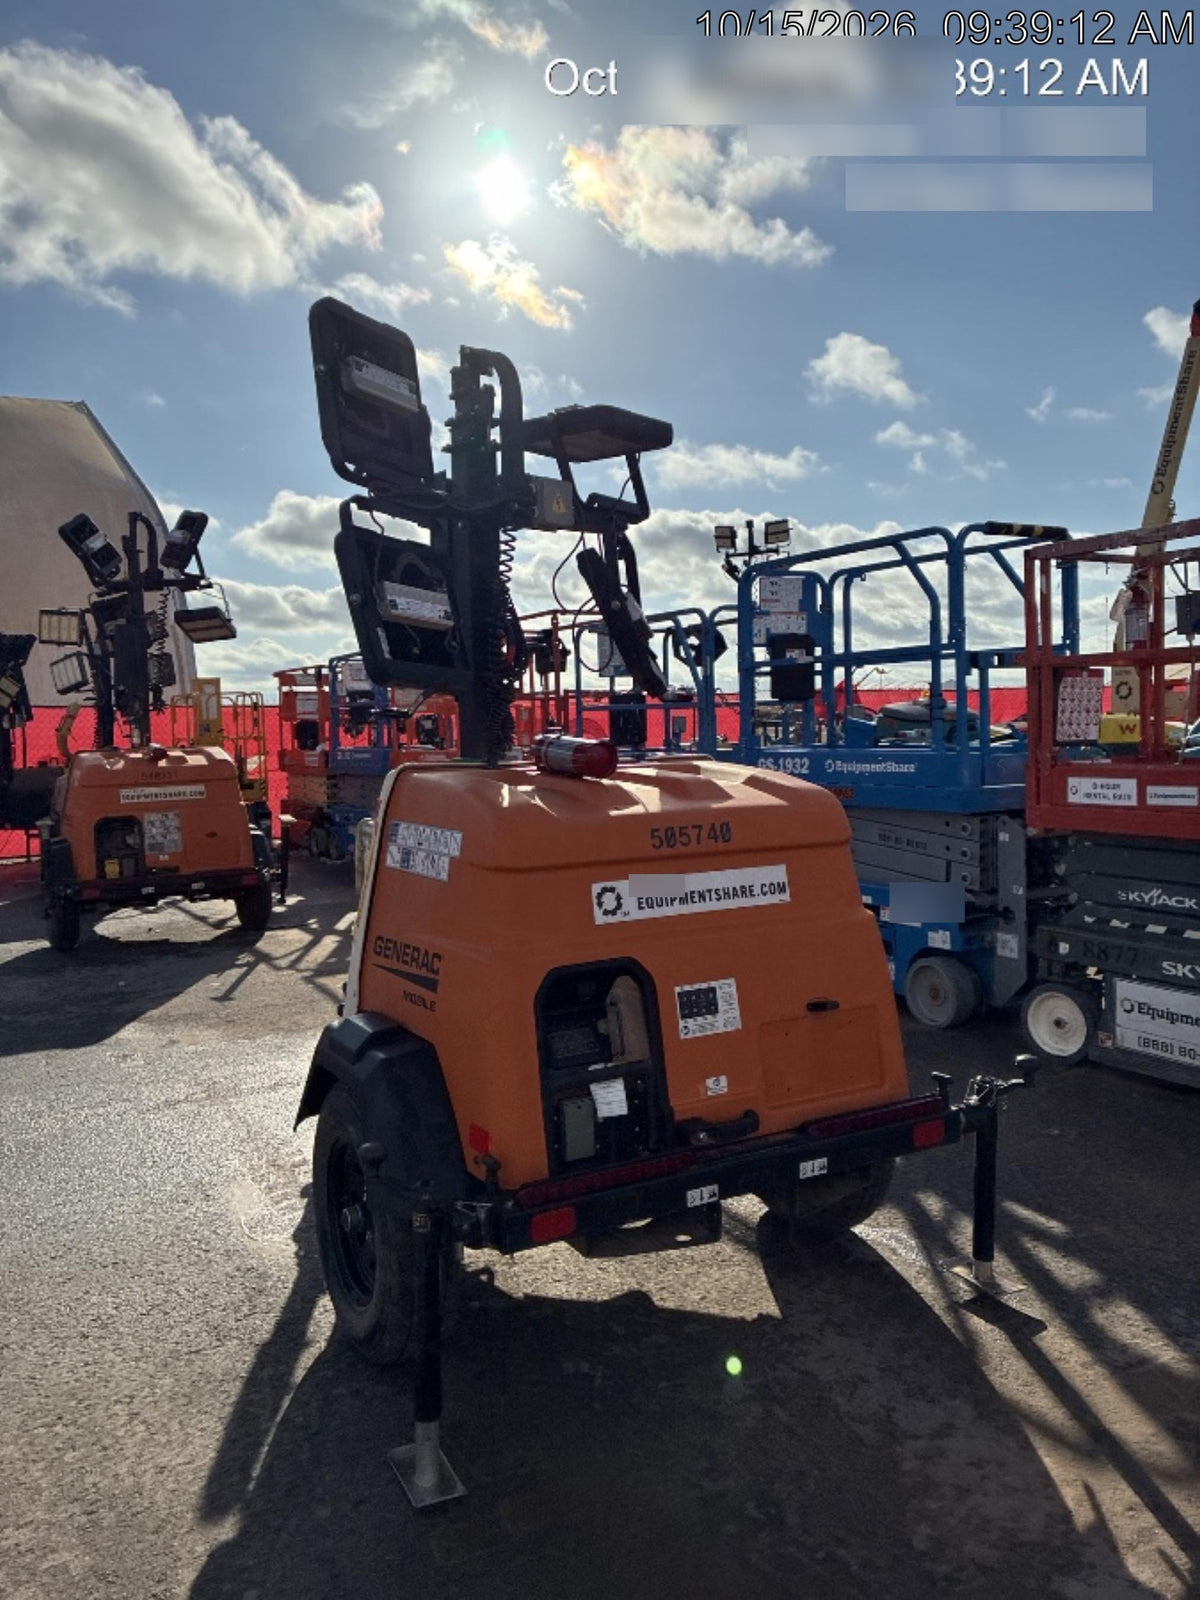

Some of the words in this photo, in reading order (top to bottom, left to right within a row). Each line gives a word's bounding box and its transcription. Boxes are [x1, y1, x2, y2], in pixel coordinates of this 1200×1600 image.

[835, 760, 916, 774] EquipmentShare
[650, 821, 732, 850] 505740
[373, 934, 442, 976] GENERAC
